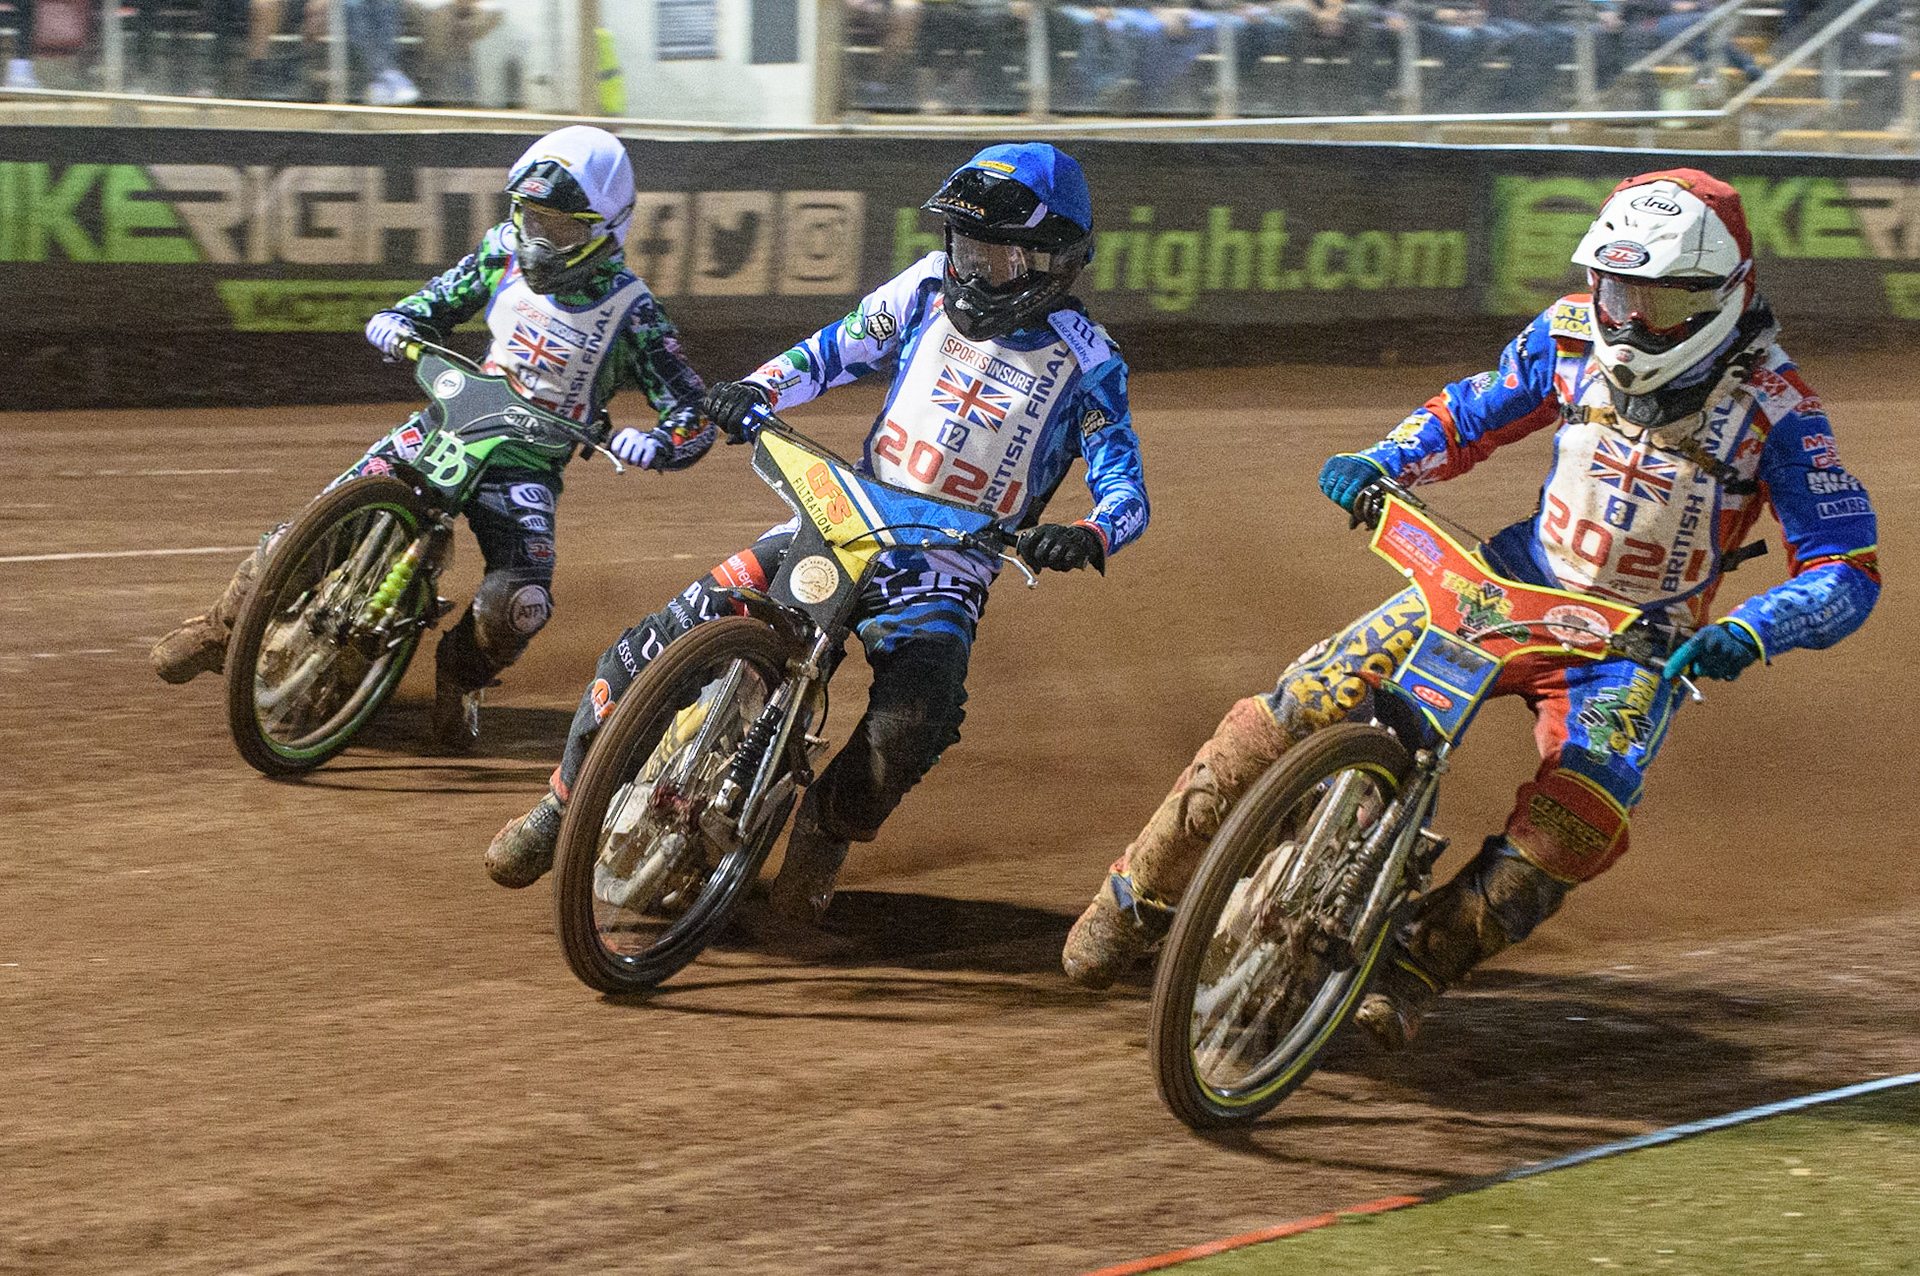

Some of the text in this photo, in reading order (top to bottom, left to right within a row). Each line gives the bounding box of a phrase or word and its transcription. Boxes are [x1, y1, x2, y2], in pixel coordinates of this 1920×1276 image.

[1643, 197, 1675, 212] Arai
[1602, 248, 1642, 262] STS
[582, 305, 615, 365] FINAL
[943, 338, 1034, 393] SPORTS INSURE
[939, 422, 967, 450] 12
[978, 348, 1070, 514] BRITISH FINAL
[805, 462, 852, 525] CFS
[874, 418, 1023, 515] 2021
[792, 477, 833, 535] FILTRATION
[1543, 493, 1707, 582] 2021
[1660, 493, 1705, 593] BRITISH
[1289, 592, 1427, 704] KEVIN
